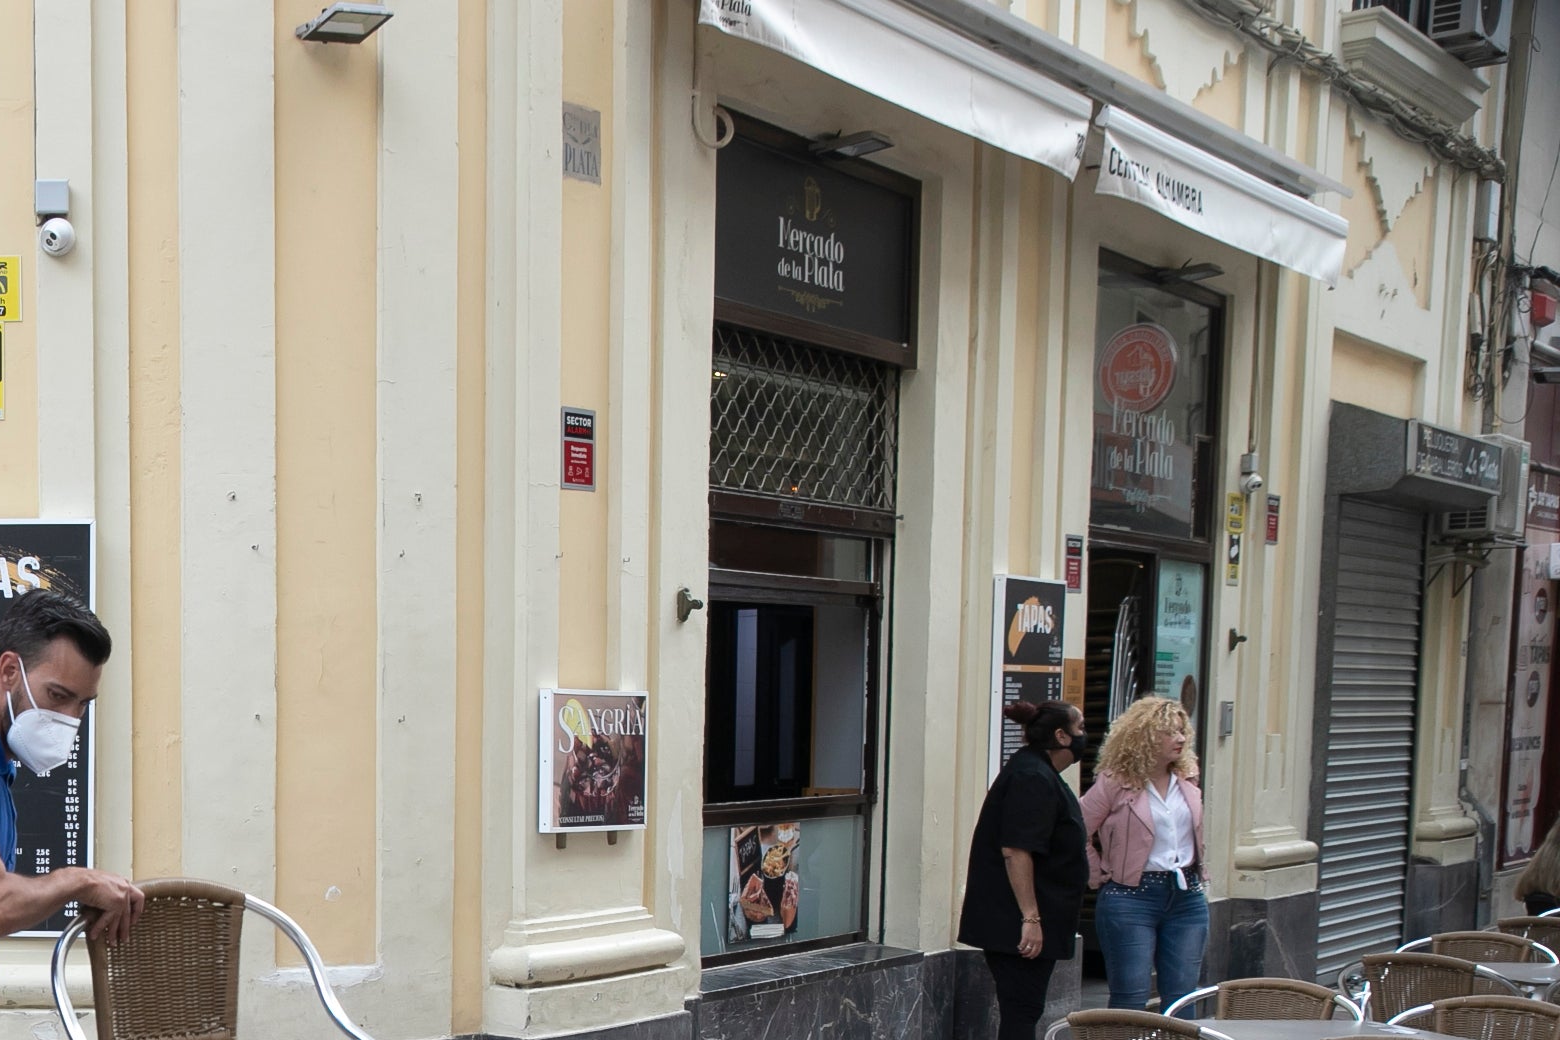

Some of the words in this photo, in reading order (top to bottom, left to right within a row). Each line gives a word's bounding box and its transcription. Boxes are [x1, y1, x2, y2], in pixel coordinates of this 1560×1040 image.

[565, 142, 599, 177] PLATA
[778, 216, 844, 263] Mercado
[778, 257, 791, 277] de
[792, 259, 802, 281] la
[803, 253, 845, 292] Plata
[566, 416, 591, 427] SECTOR
[1017, 603, 1052, 634] TAPAS
